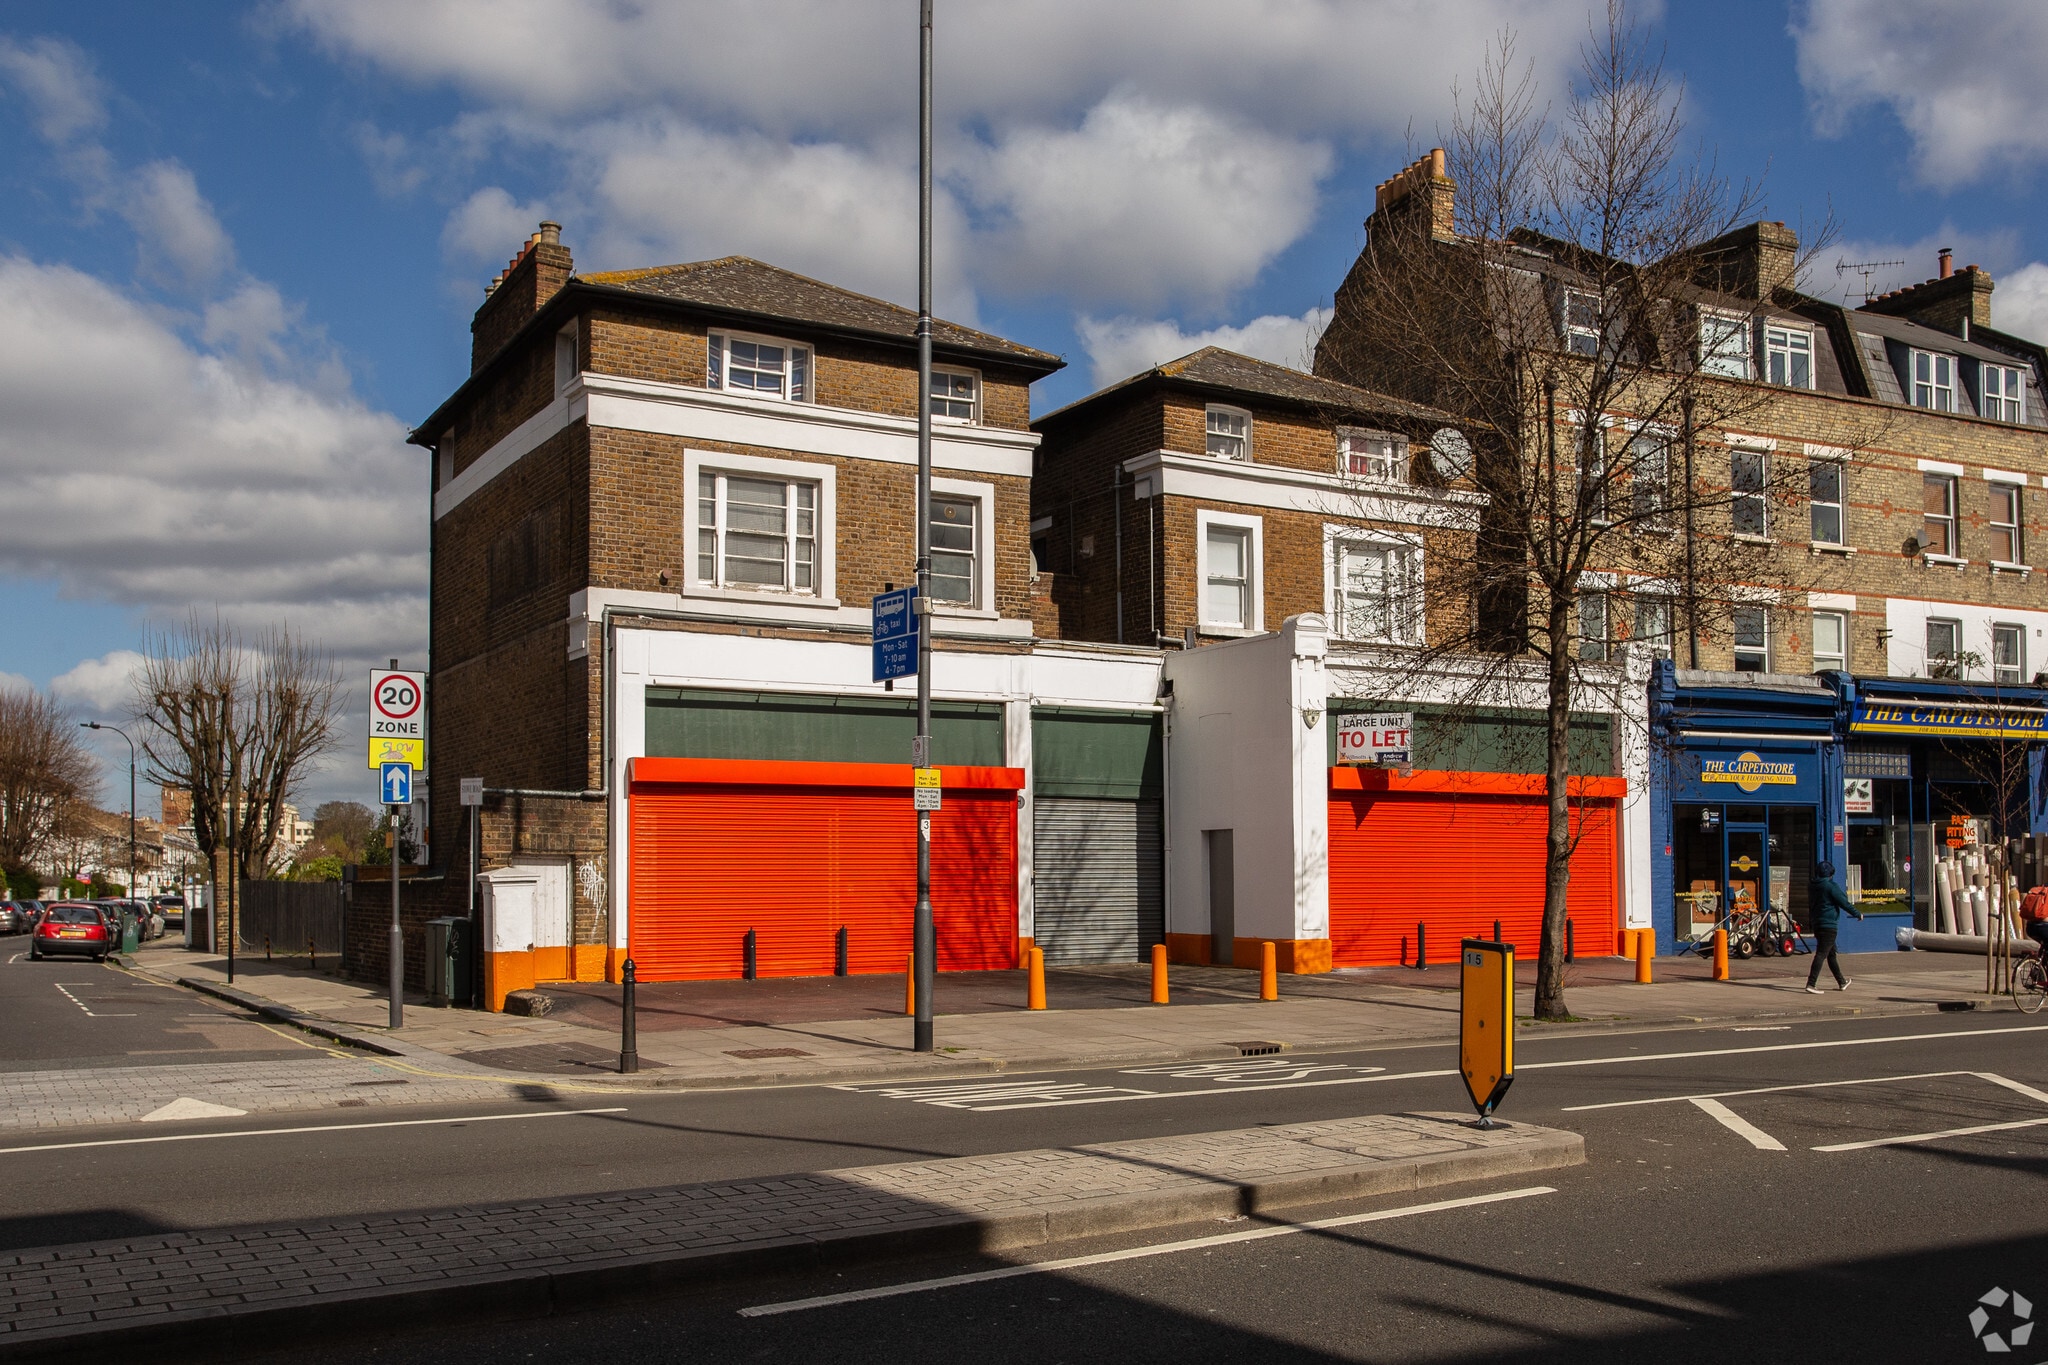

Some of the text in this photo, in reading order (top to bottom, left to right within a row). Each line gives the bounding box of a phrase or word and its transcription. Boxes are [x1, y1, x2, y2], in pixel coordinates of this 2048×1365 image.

[890, 619, 901, 629] taxi
[882, 643, 894, 653] Mon
[897, 640, 908, 649] Sat
[382, 687, 415, 706] 20
[1343, 717, 1404, 727] LARGE UNIT
[1864, 704, 2047, 728] THE CARPETSTORE
[376, 721, 418, 734] ZONE
[1339, 730, 1409, 748] TO LET
[381, 741, 414, 753] SLOW
[1705, 761, 1795, 774] THE CARPETSTORE
[923, 821, 930, 830] 3
[1951, 815, 1971, 825] FAST
[1946, 827, 1975, 837] FITTING
[1846, 888, 1907, 896] www.hecarpetstore.info
